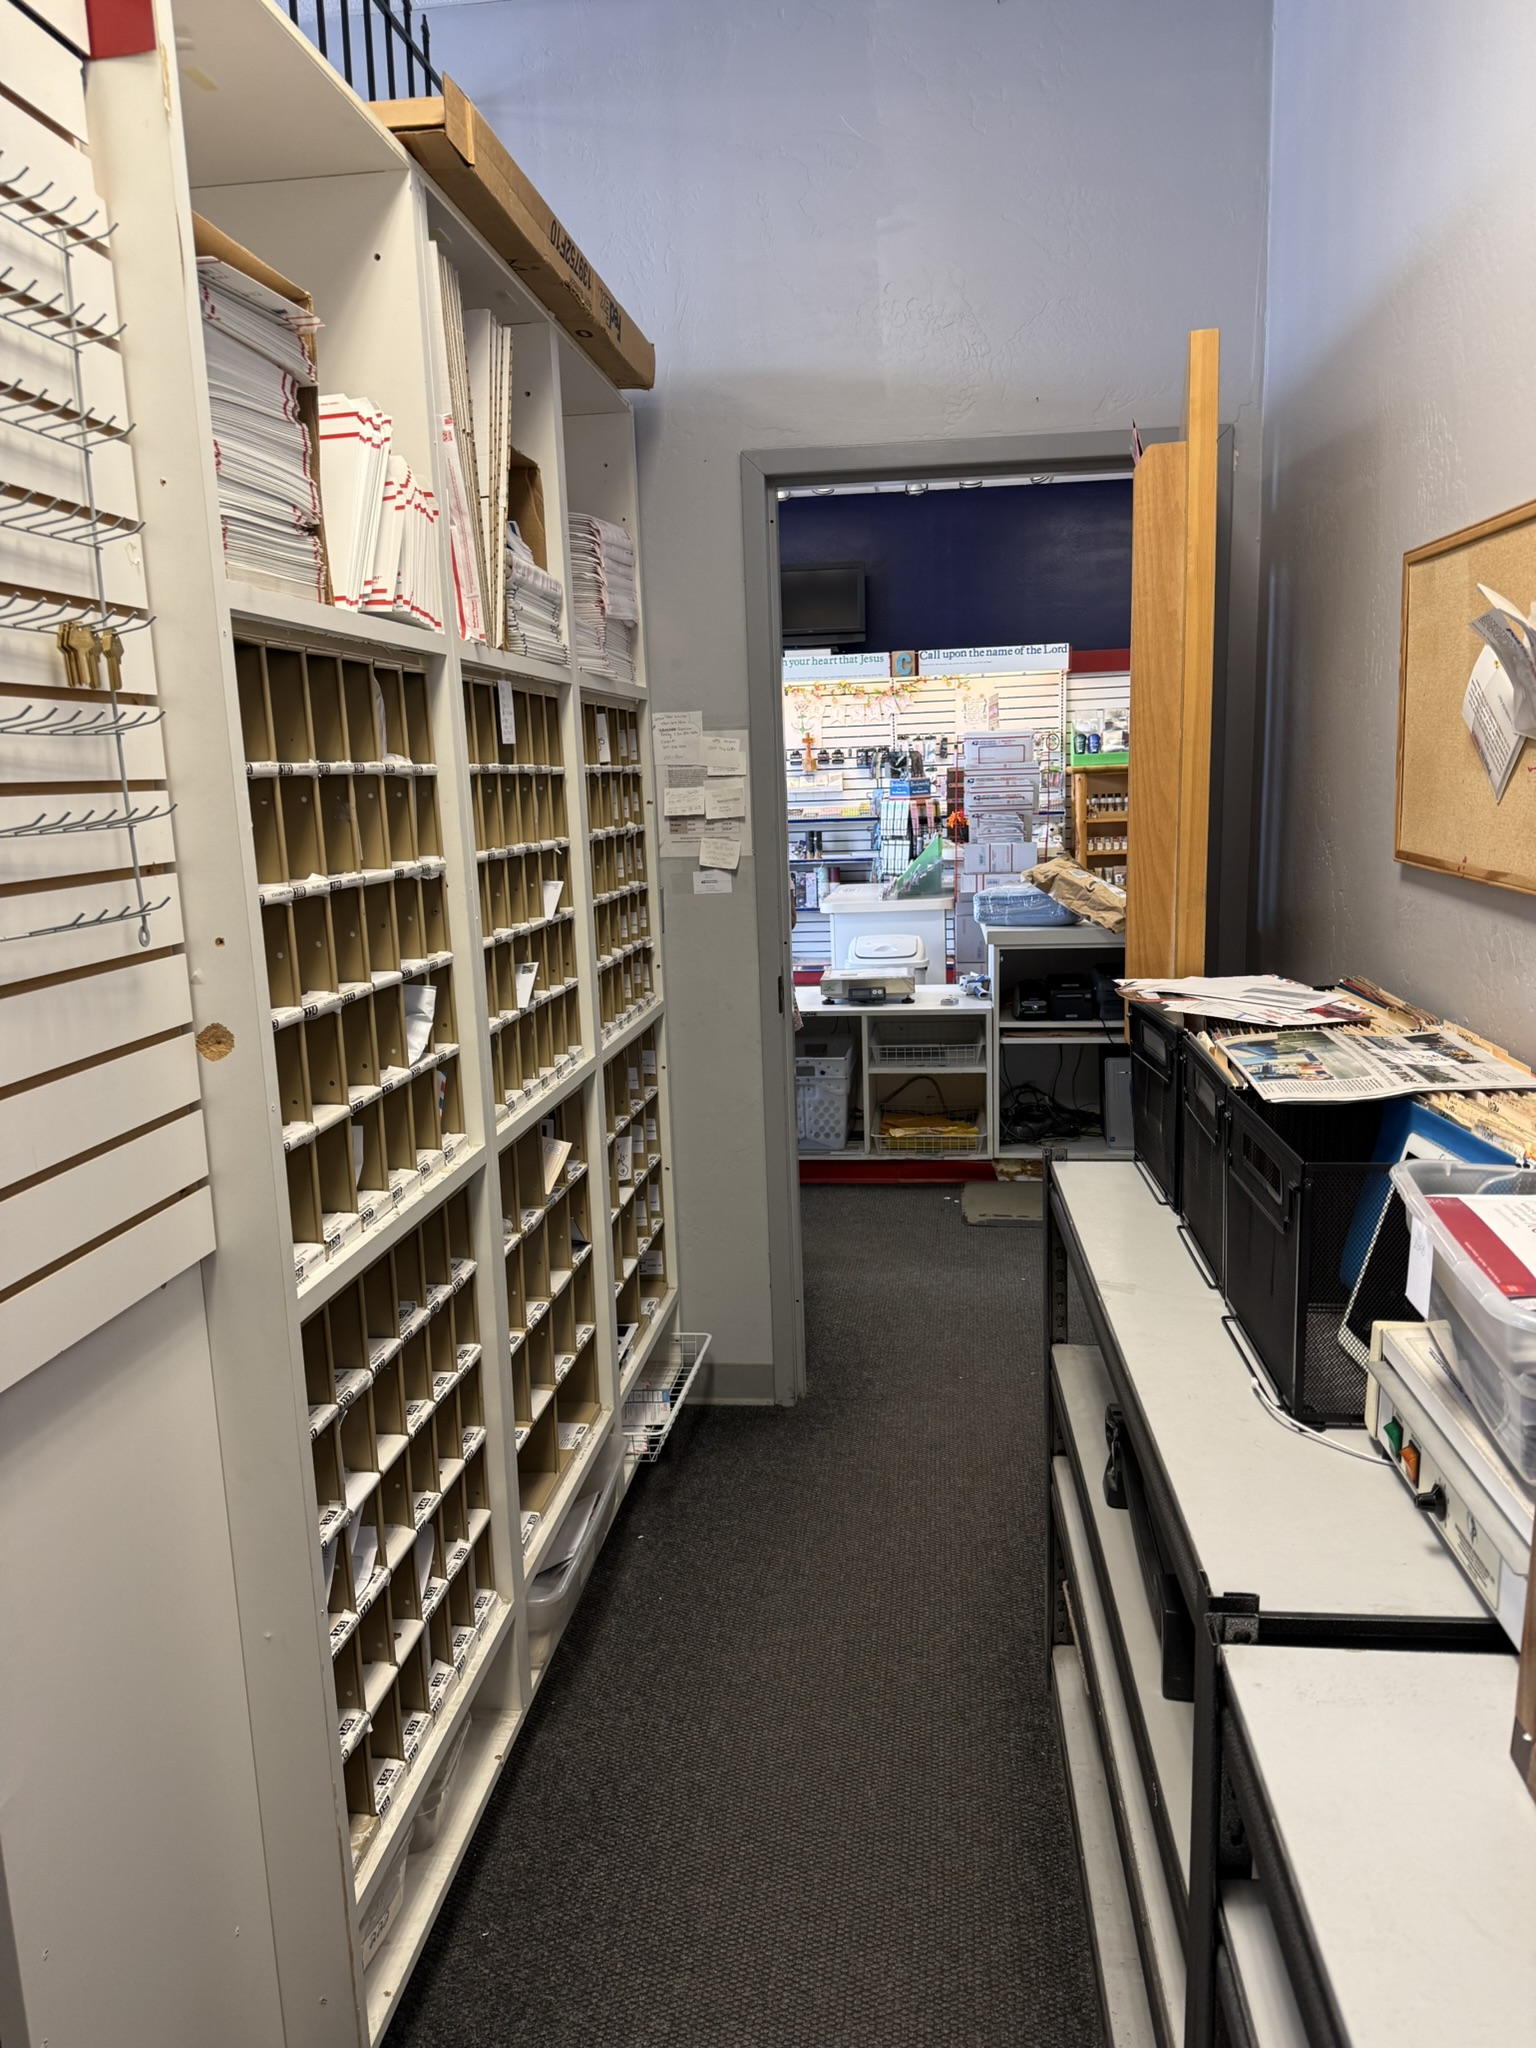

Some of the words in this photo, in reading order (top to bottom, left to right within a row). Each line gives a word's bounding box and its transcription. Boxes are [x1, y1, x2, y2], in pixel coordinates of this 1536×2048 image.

[550, 219, 591, 291] 139752F10
[919, 650, 940, 661] Call
[943, 649, 967, 661] upon
[969, 648, 985, 658] the
[986, 647, 1012, 657] name
[1014, 645, 1025, 656] of
[1026, 645, 1042, 655] the
[1043, 644, 1068, 654] Lord
[789, 657, 811, 670] your
[812, 656, 837, 666] heart
[839, 655, 858, 665] that
[860, 654, 885, 665] Jesus
[896, 652, 911, 676] C
[321, 1510, 337, 1525] 137
[423, 1587, 438, 1599] 152
[331, 1620, 349, 1636] 143
[339, 1718, 355, 1735] 149
[405, 1720, 420, 1735] 157
[377, 1769, 394, 1785] 156
